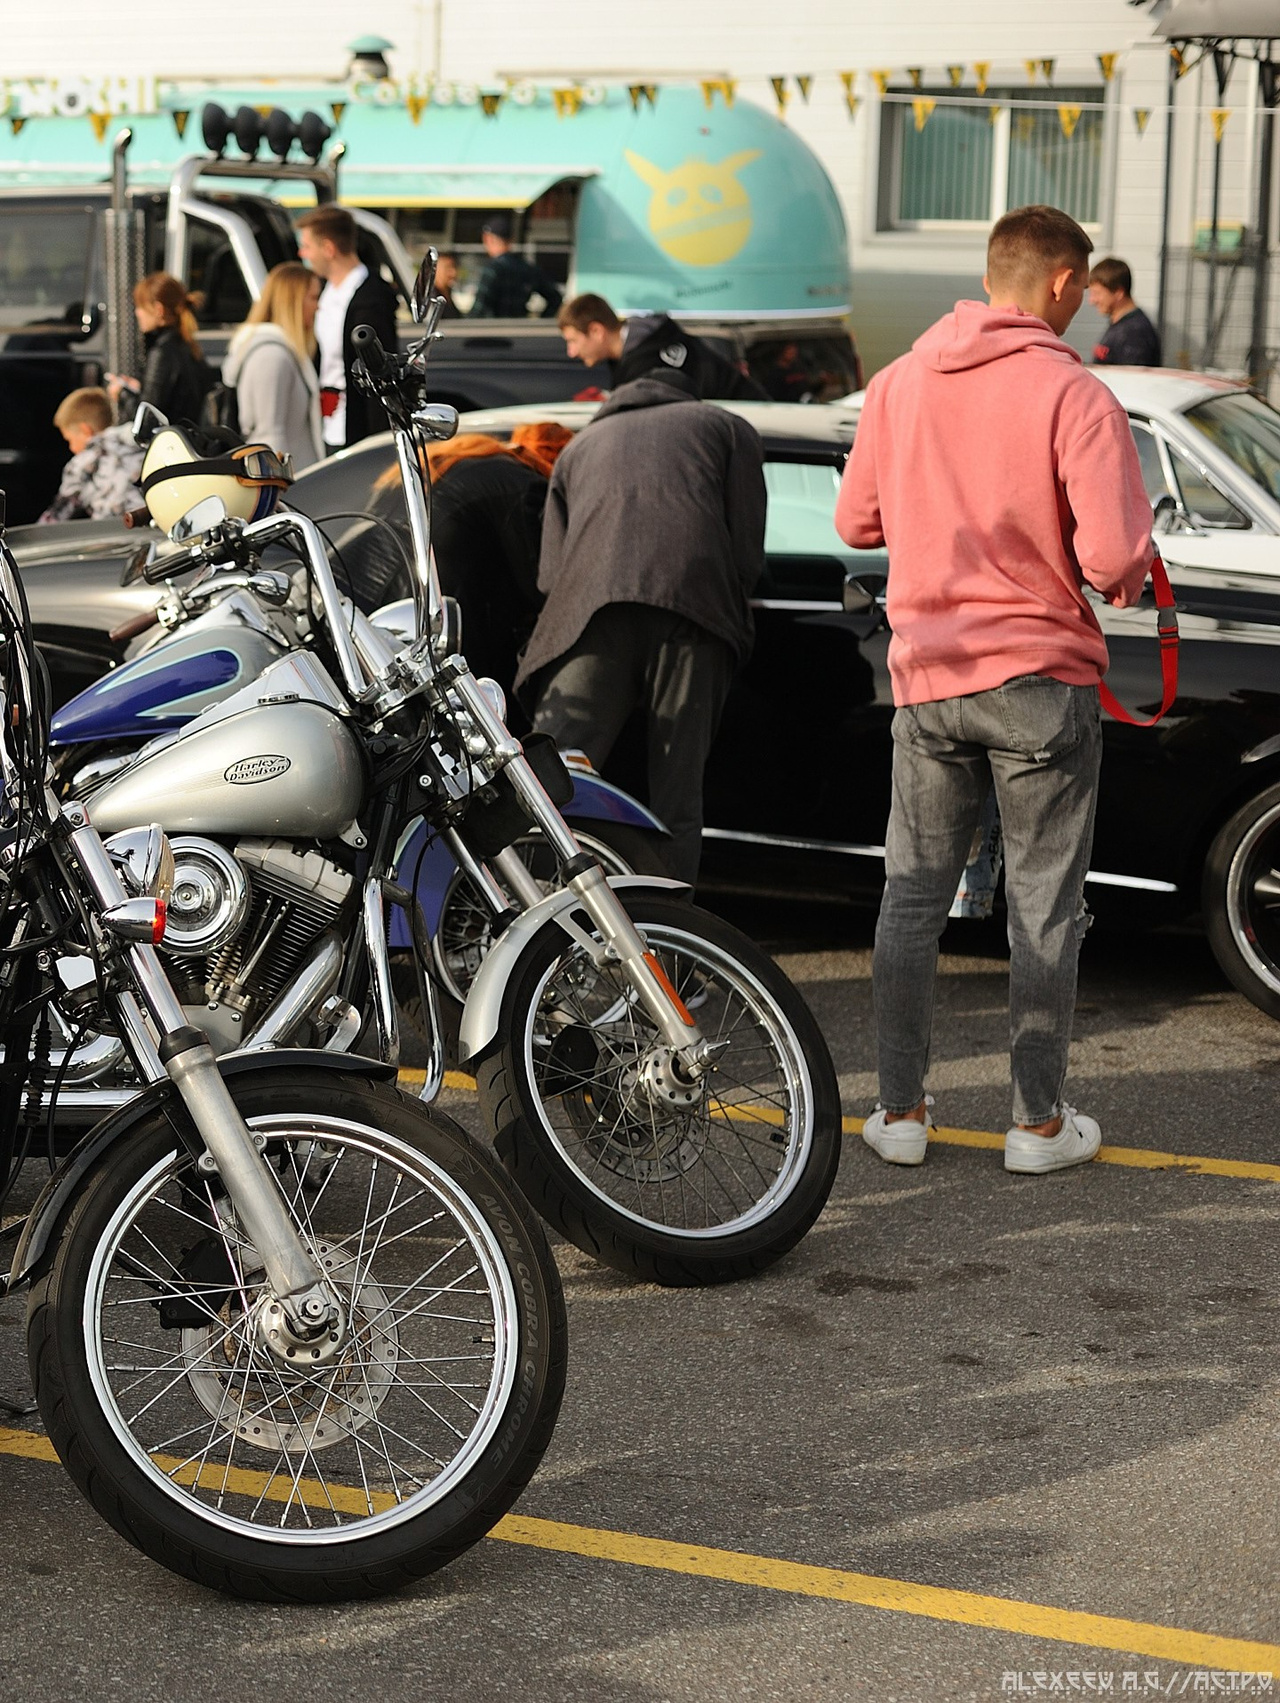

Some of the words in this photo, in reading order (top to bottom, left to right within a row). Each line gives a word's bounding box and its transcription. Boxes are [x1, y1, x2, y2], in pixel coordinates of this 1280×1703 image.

[229, 764, 285, 781] Davidson
[479, 1192, 524, 1254] AVON
[517, 1262, 540, 1348] COBRA
[490, 1359, 537, 1470] CHROME
